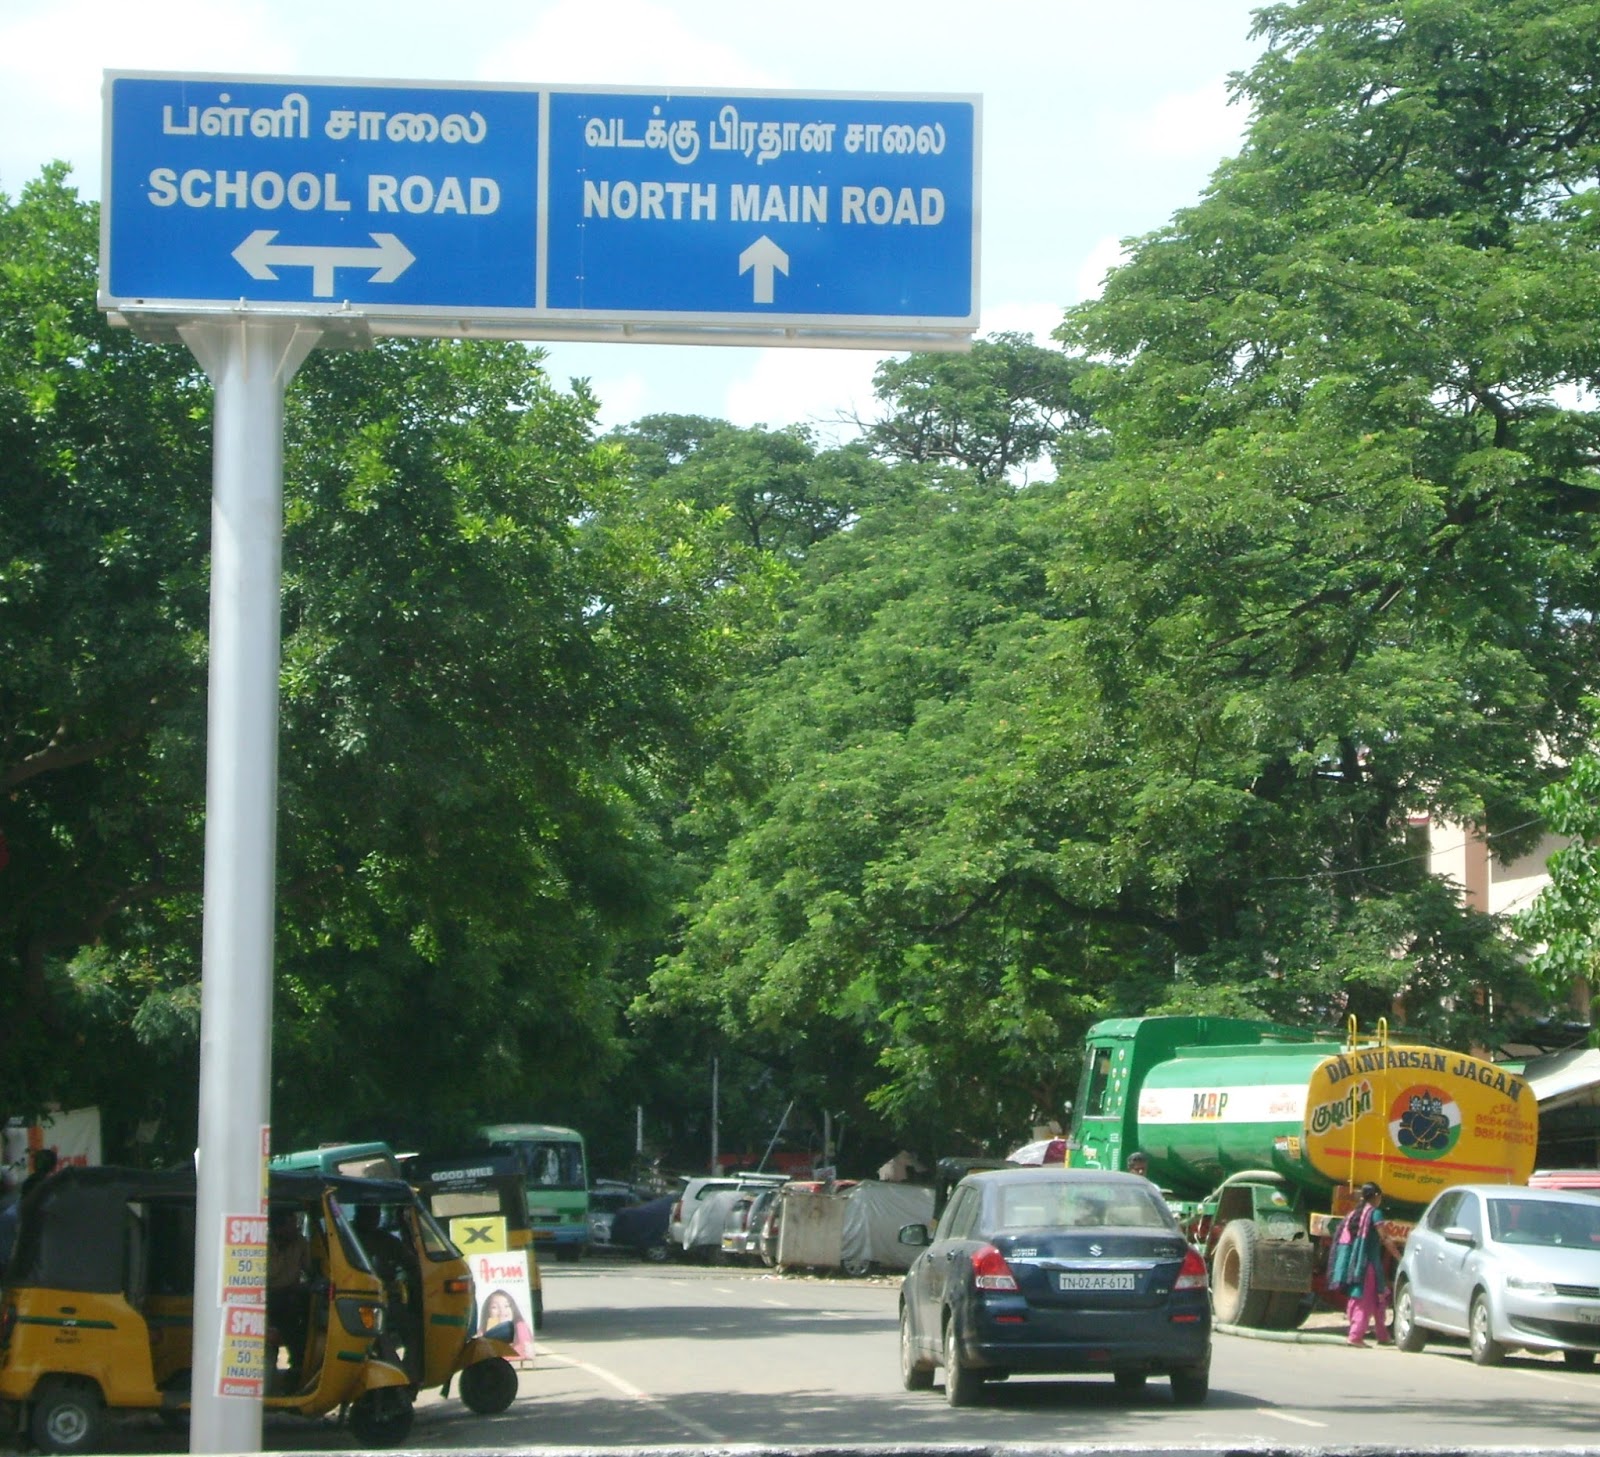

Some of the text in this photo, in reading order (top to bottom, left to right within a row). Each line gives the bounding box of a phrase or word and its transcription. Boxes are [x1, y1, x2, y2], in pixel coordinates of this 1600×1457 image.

[163, 92, 487, 144] பள்ளி சாலை
[584, 104, 947, 166] வடக்கு பிரதான சாலை
[147, 167, 501, 215] SCHOOL ROAD
[583, 180, 945, 226] NORTH MAIN ROAD
[1453, 1060, 1524, 1102] JAGAN
[431, 1166, 494, 1182] GOOD WILL
[238, 1260, 252, 1273] 50
[1062, 1276, 1134, 1289] TN-02-AF-6121
[237, 1351, 251, 1364] 50
